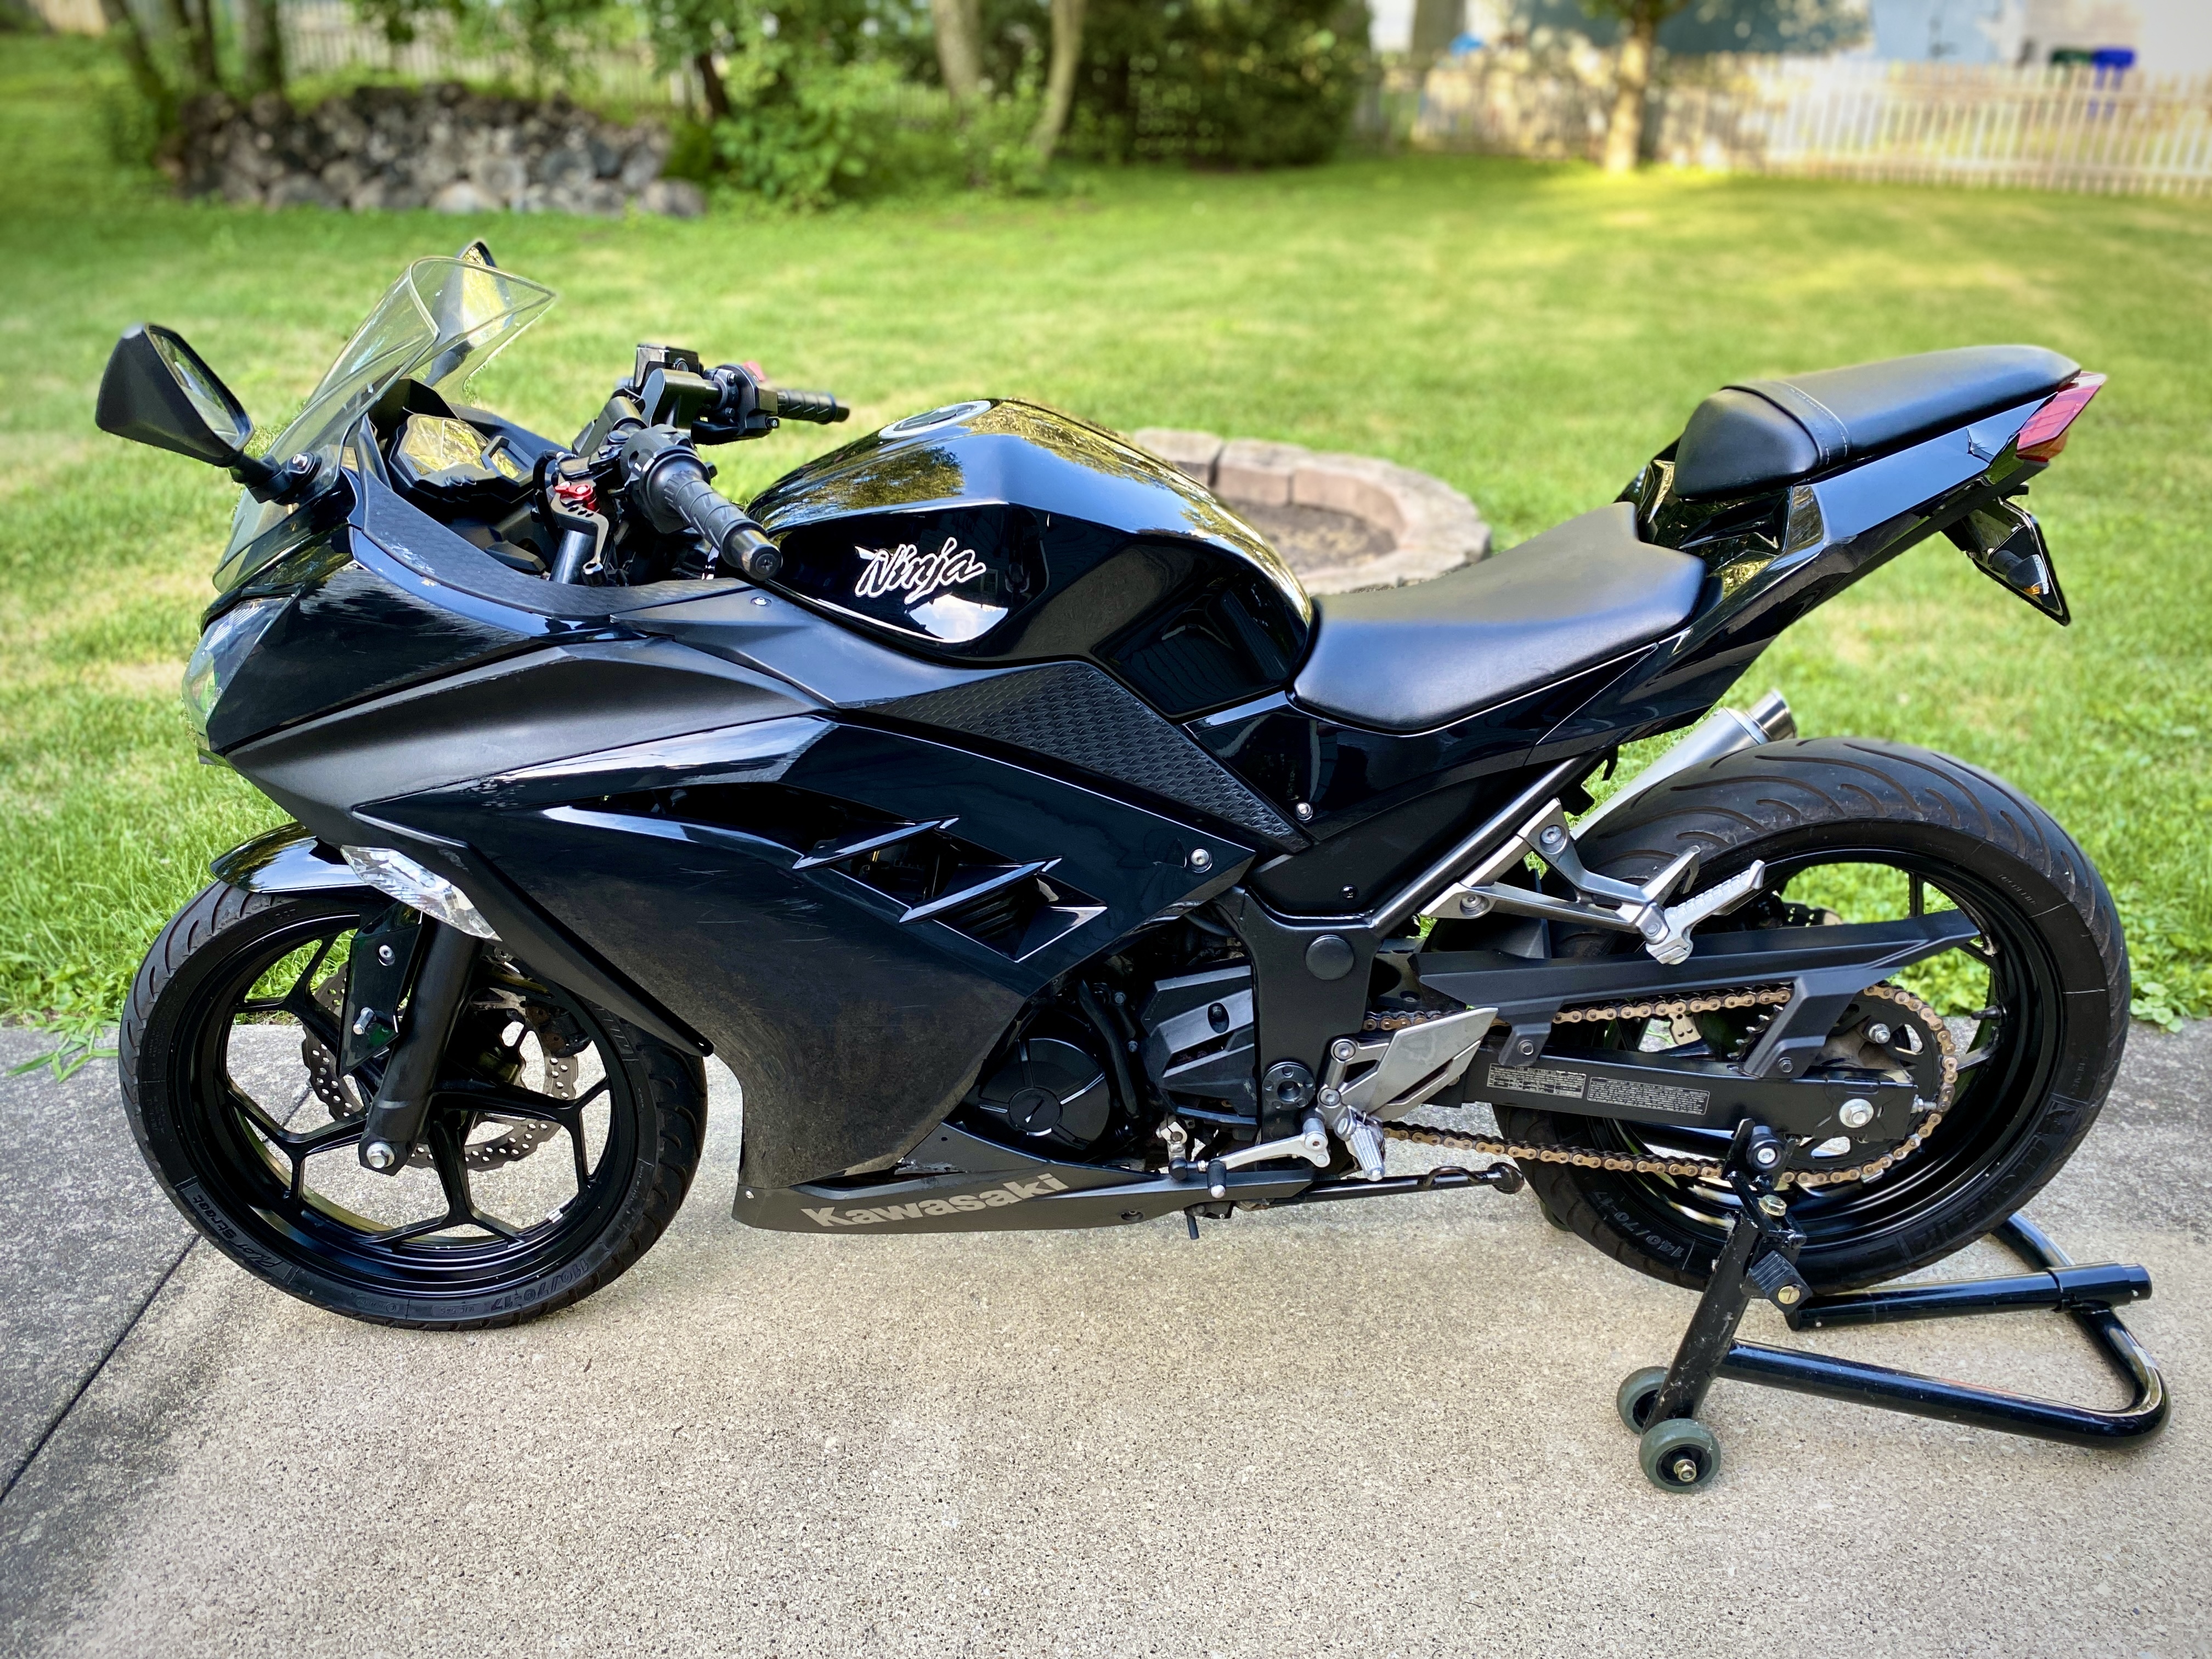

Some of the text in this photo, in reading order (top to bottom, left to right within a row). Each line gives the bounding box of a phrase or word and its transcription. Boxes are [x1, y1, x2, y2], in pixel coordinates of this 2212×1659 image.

[854, 537, 986, 605] Ninja
[193, 1194, 237, 1239] Street
[800, 1172, 1070, 1228] Kawasaki
[1592, 1191, 1685, 1257] 140/70-17
[490, 1258, 589, 1313] 110/70-17
